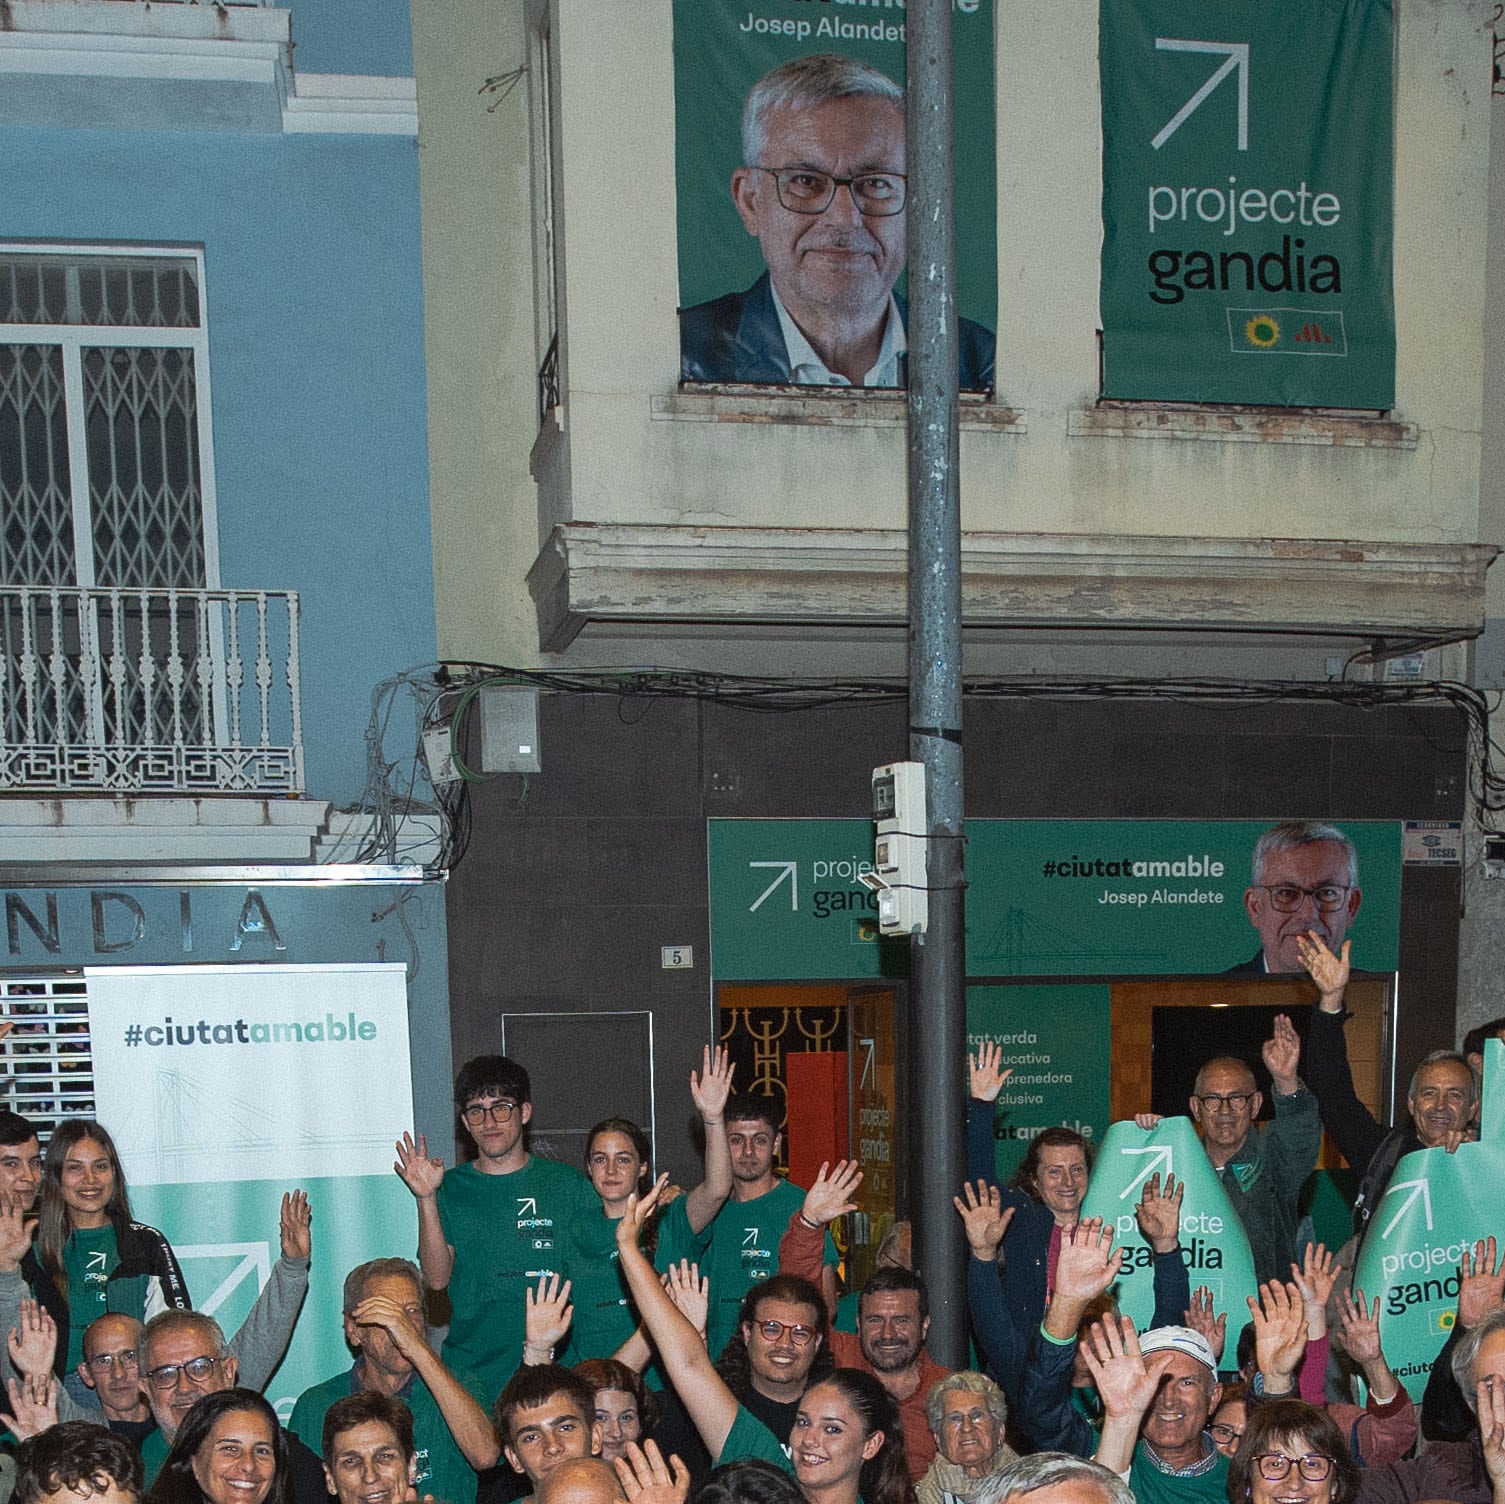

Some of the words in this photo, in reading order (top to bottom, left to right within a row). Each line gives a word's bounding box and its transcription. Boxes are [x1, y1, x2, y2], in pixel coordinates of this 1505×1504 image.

[739, 13, 810, 41] Josep
[815, 16, 907, 42] Alandet
[1148, 176, 1341, 235] projecte
[1147, 234, 1341, 305] gandia
[812, 856, 874, 884] proje
[1043, 855, 1224, 878] #ciutatamable
[812, 890, 877, 918] gan
[1098, 889, 1147, 908] Josep
[1150, 888, 1224, 905] Alandete
[673, 951, 681, 965] 5
[124, 1012, 378, 1047] #ciutatamable
[995, 1030, 1037, 1045] verda
[1000, 1052, 1051, 1065] ucativa
[1003, 1072, 1073, 1088] prenedora
[998, 1092, 1044, 1105] clusiva
[1118, 1238, 1223, 1275] gadia
[84, 1272, 108, 1283] proje
[1386, 1266, 1461, 1316] gand
